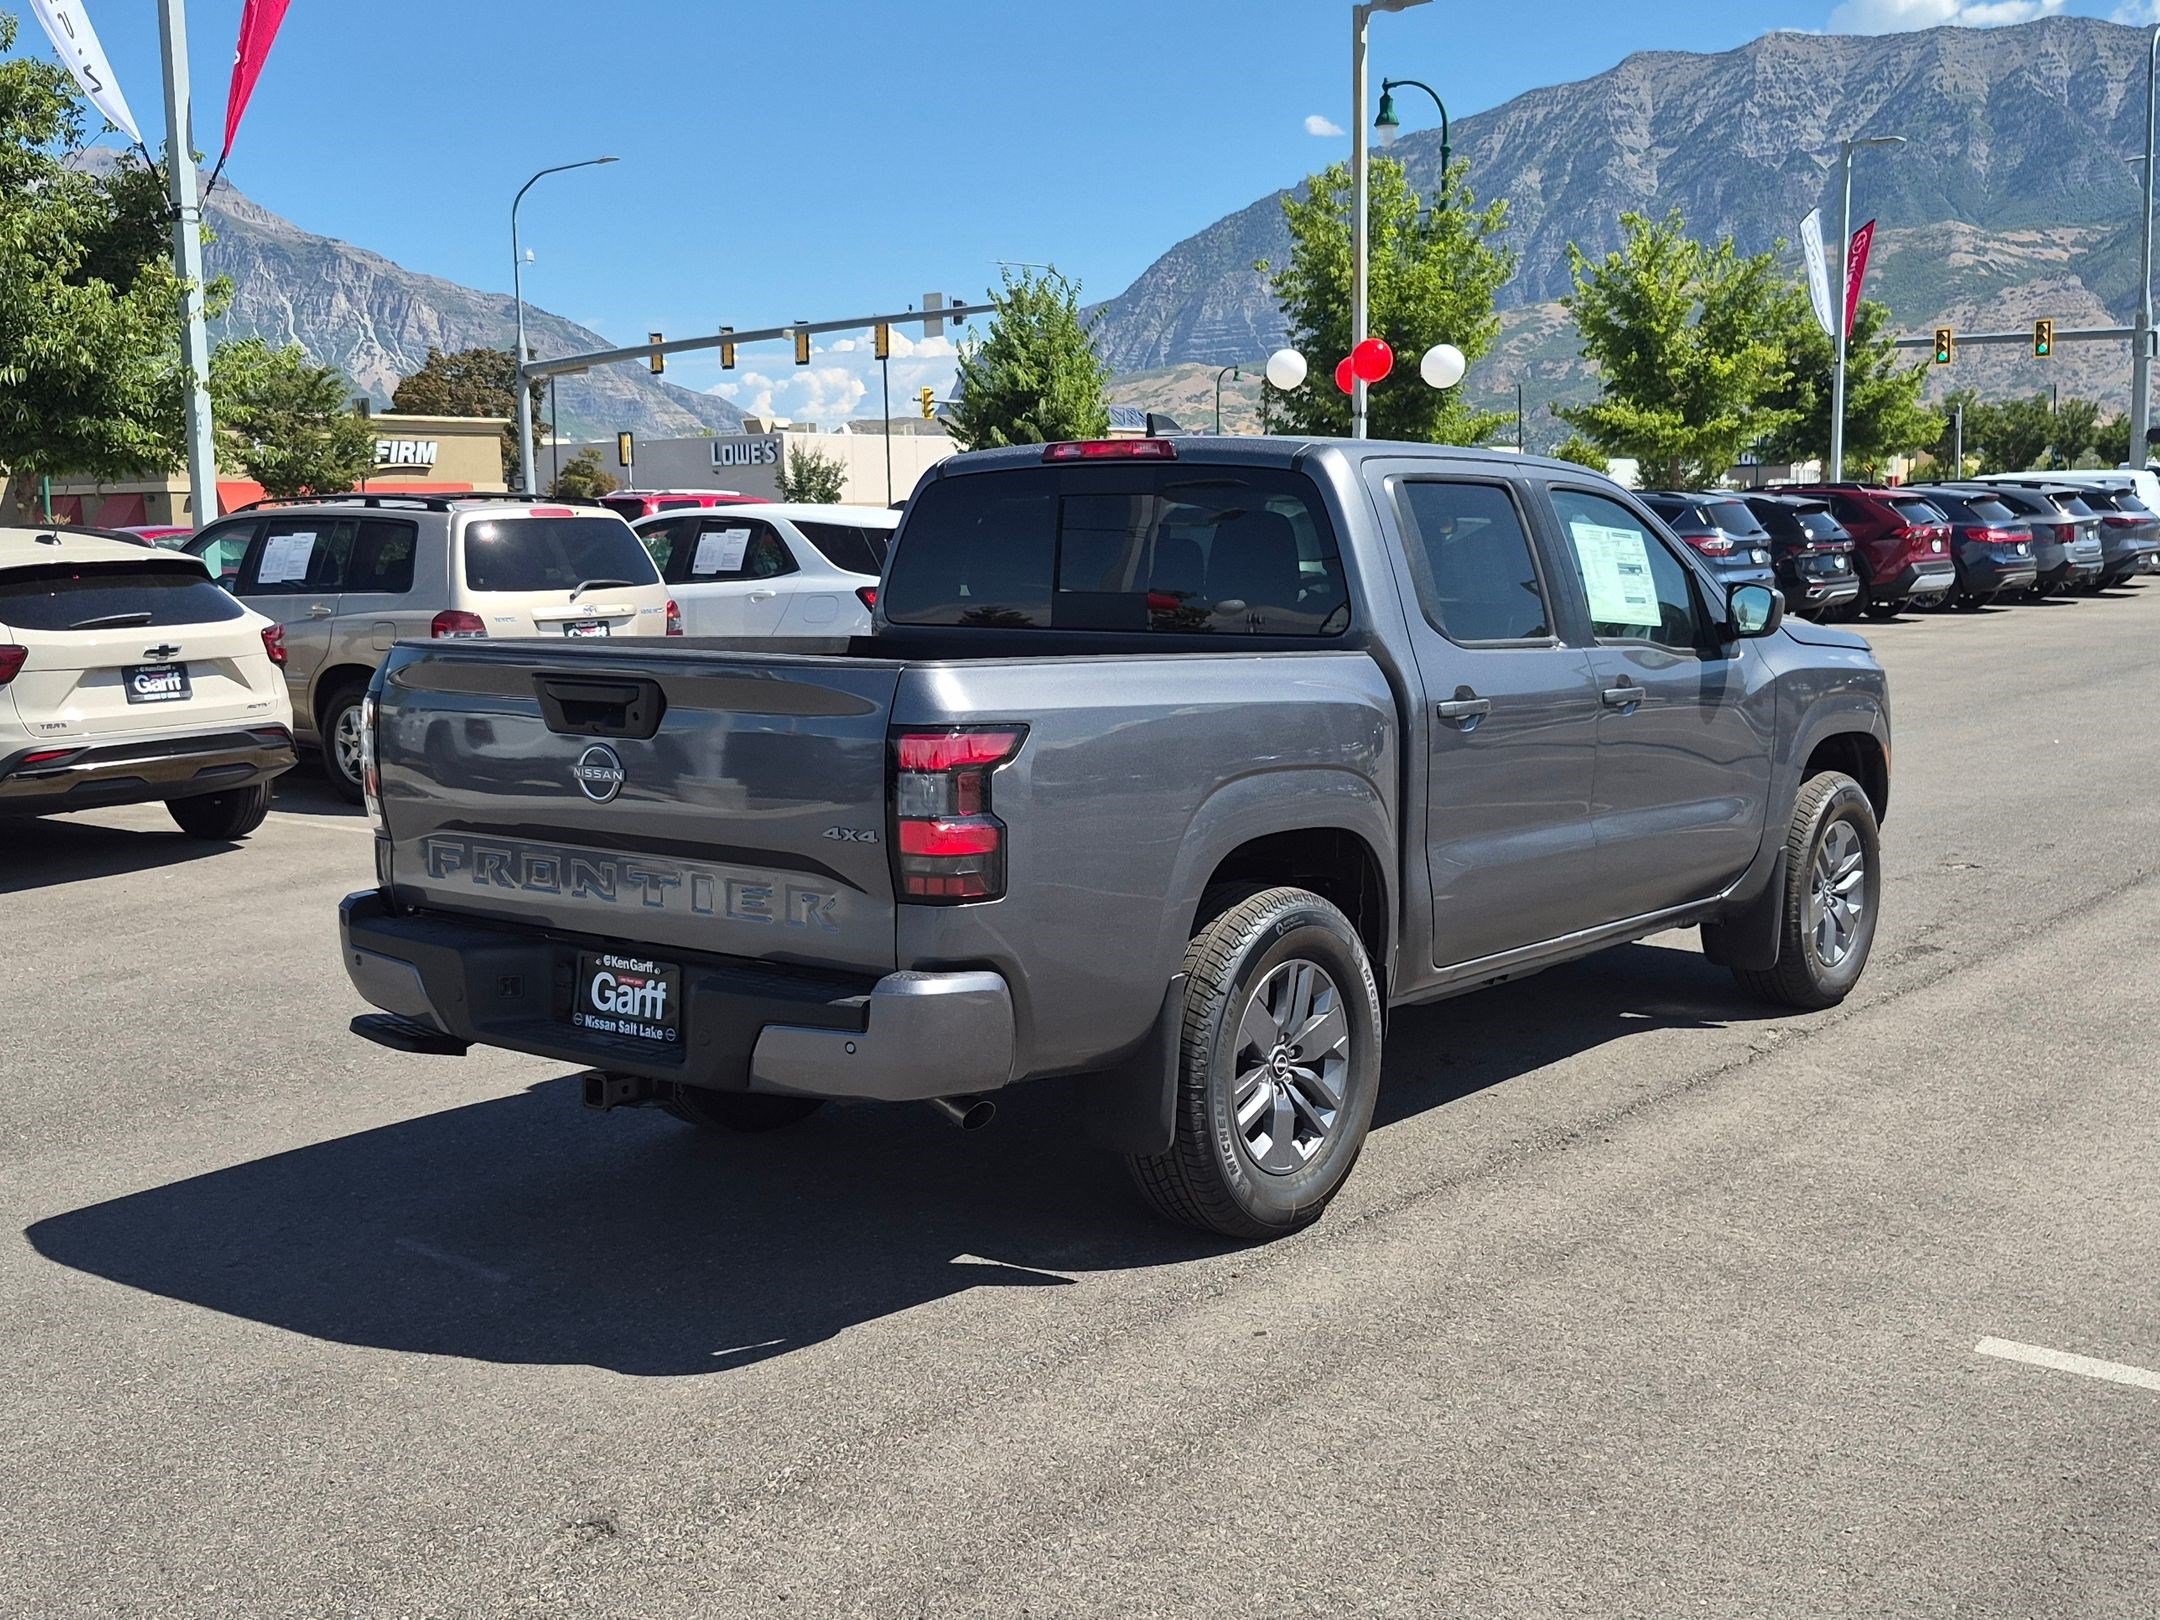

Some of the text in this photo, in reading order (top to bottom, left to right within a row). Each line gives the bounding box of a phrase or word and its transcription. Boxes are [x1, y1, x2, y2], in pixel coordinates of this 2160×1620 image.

[373, 440, 438, 464] FIRM
[710, 440, 776, 466] LOWE'S
[134, 672, 182, 694] Garff
[573, 767, 623, 780] NISSAN
[426, 839, 840, 934] FRONTIER
[611, 955, 654, 974] Ken Garff
[591, 971, 667, 1020] Garff
[584, 1014, 664, 1040] Nissan Salt Lake
[1213, 1077, 1240, 1178] MICHELIN
